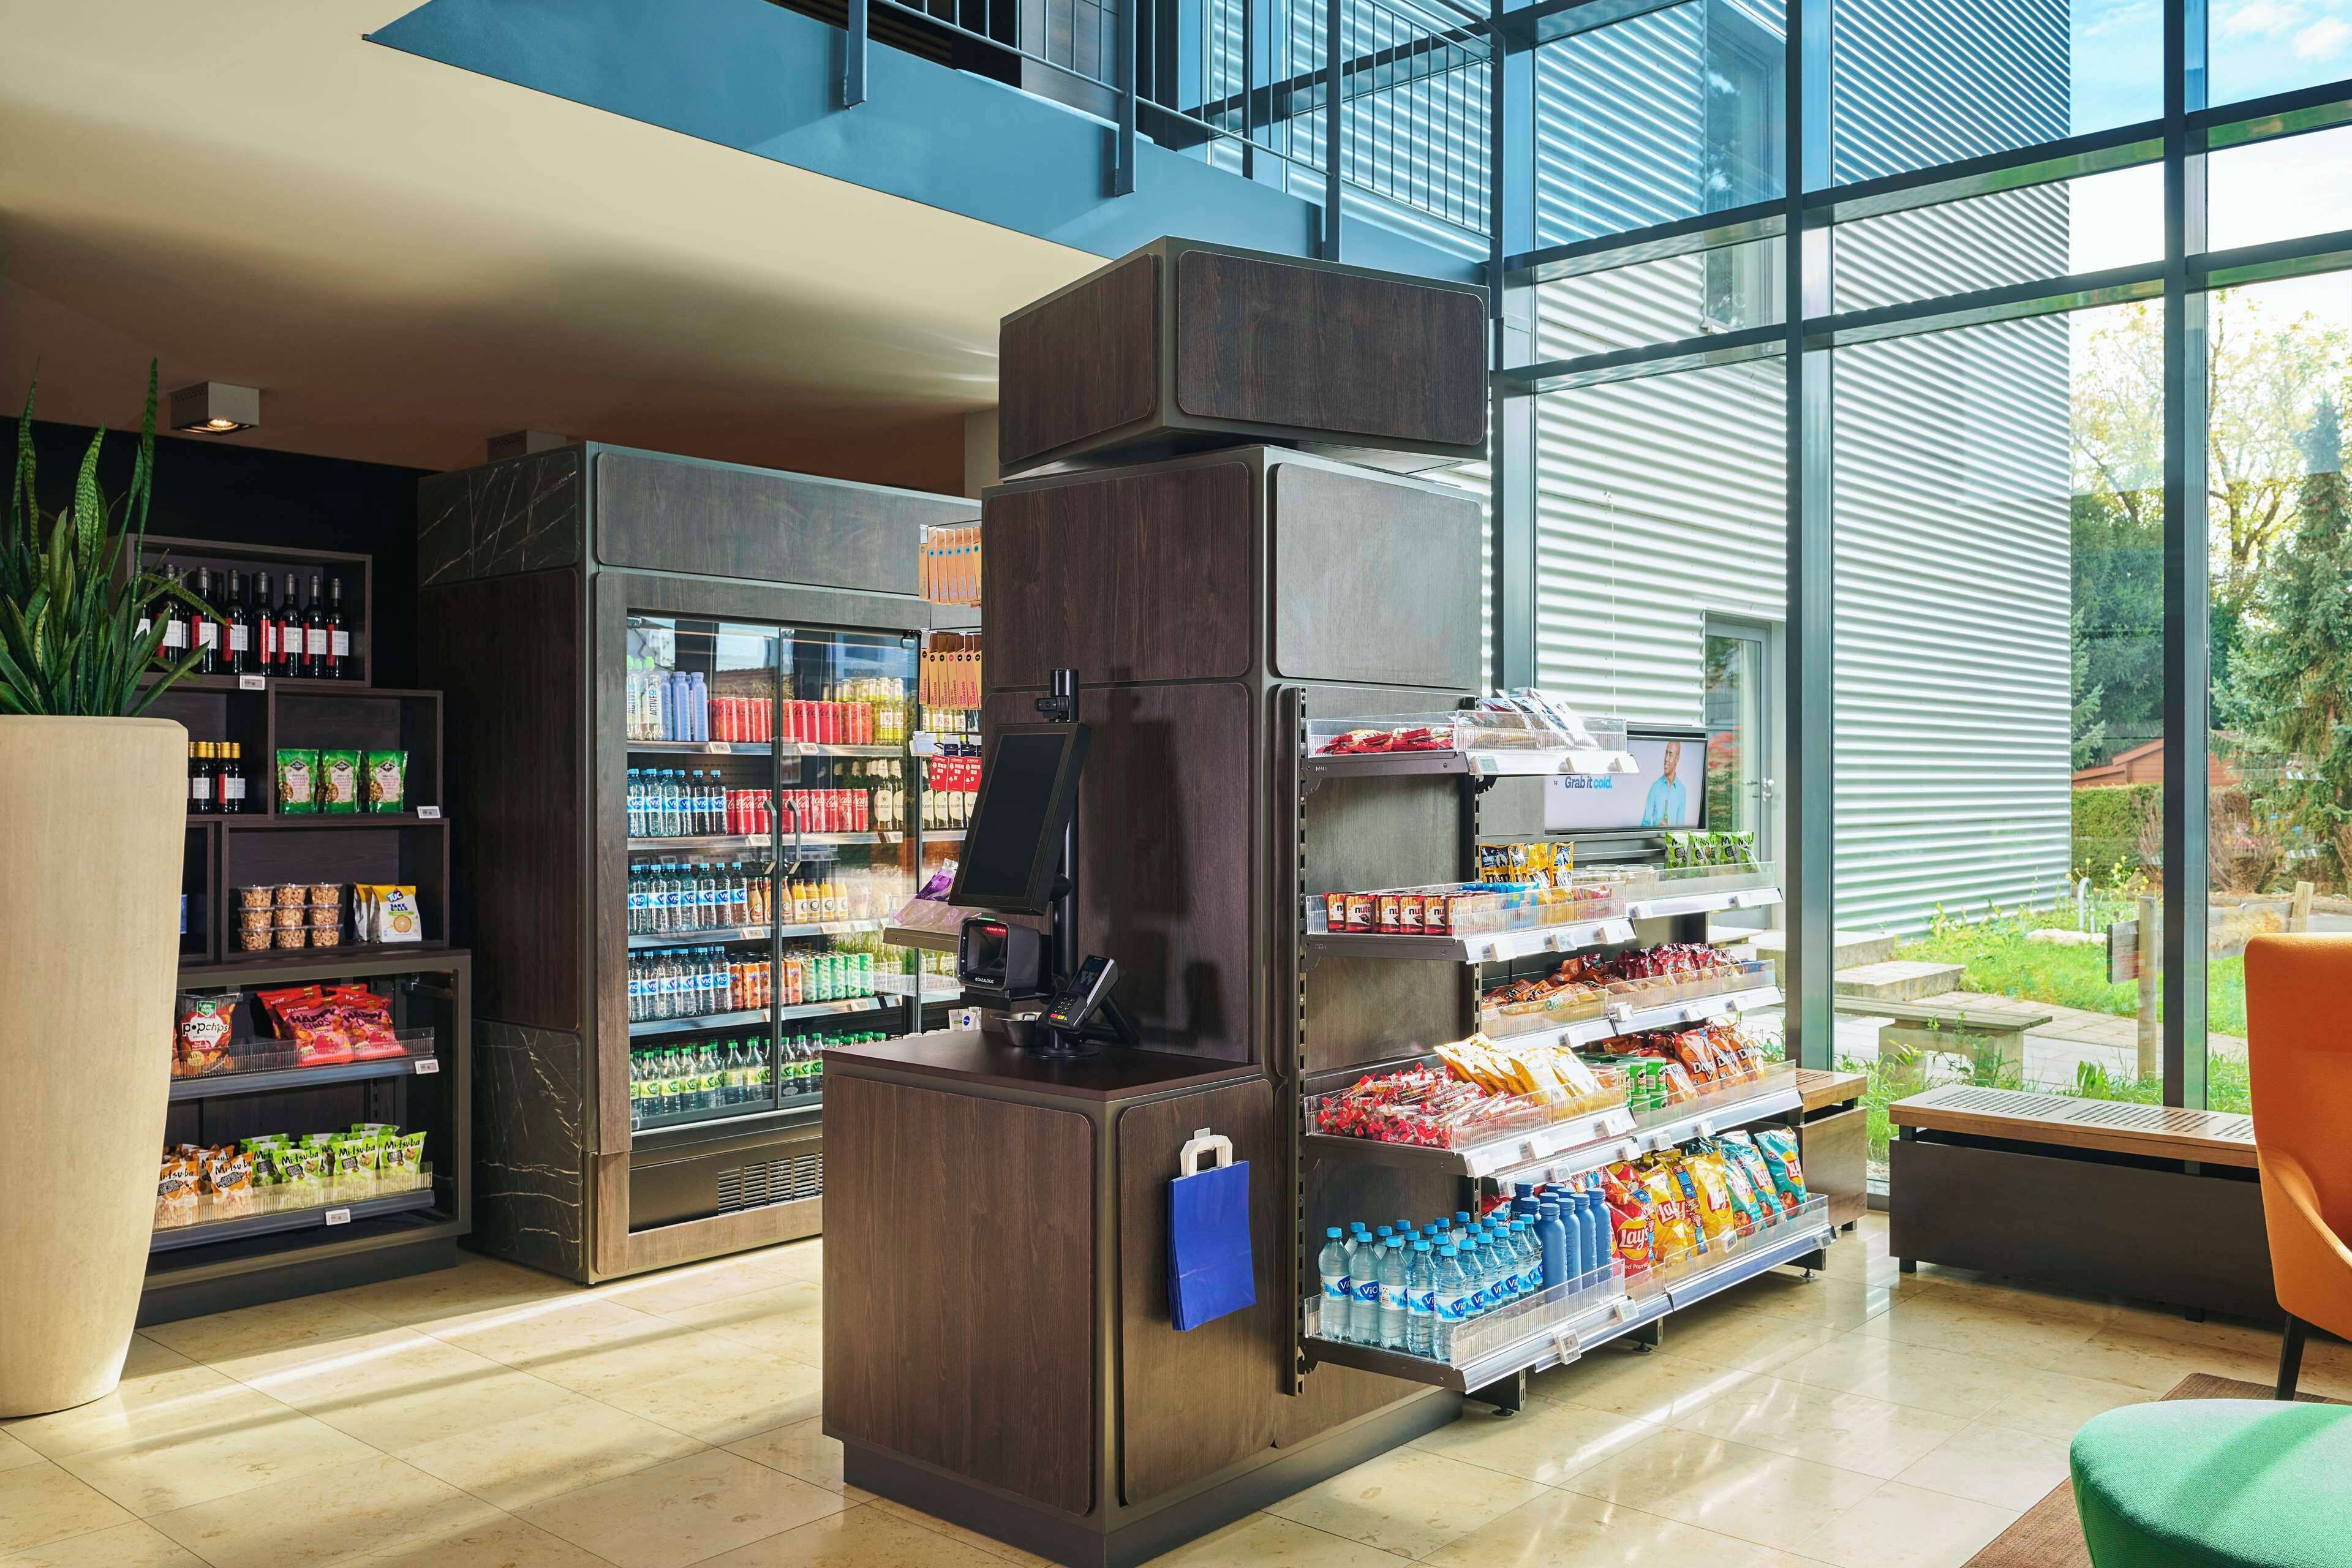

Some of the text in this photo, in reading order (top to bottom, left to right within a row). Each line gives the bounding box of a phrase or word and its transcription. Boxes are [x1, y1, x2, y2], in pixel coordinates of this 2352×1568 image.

[1565, 775, 1585, 789] Grab
[1586, 775, 1593, 789] it
[1594, 775, 1613, 789] cold.
[389, 892, 402, 902] TUC
